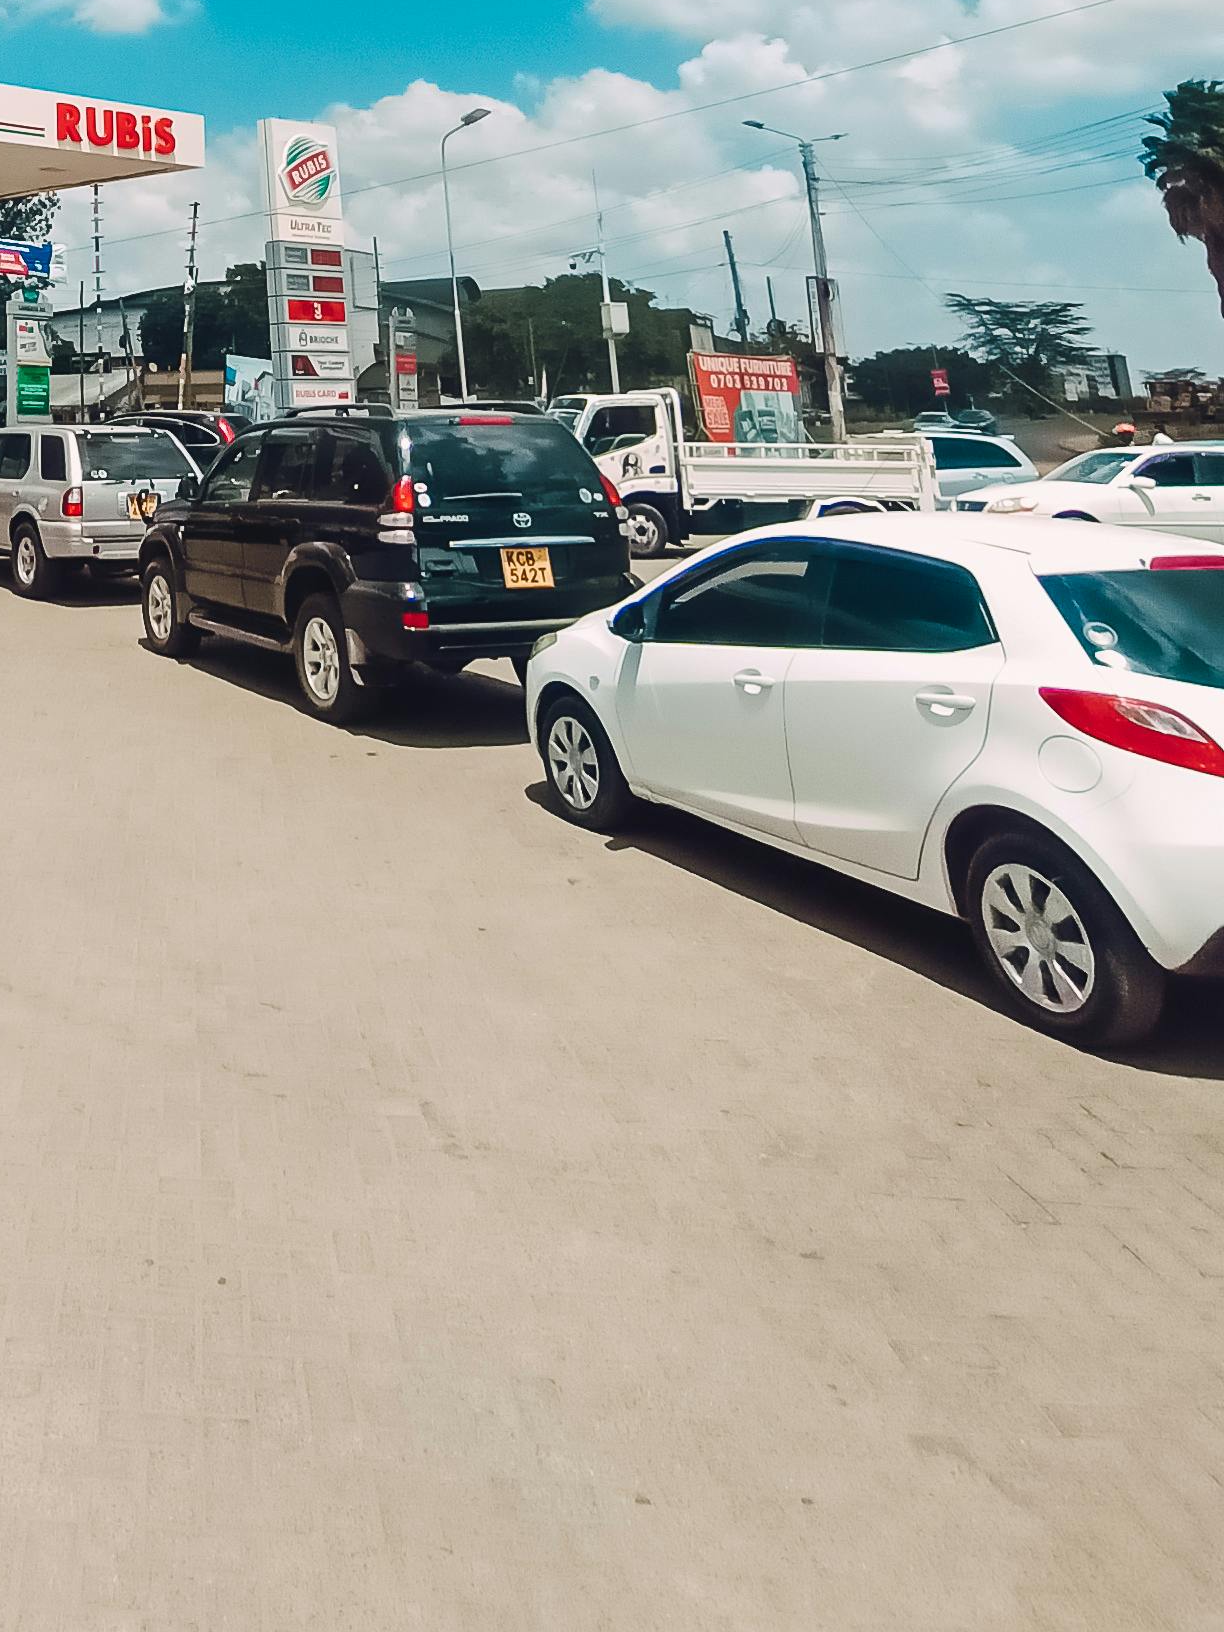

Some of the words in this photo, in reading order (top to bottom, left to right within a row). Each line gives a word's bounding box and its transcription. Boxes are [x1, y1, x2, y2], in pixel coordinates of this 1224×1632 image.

[291, 154, 327, 184] RUBIS
[698, 356, 740, 373] UNIQUE
[740, 358, 792, 376] FURNITURE
[710, 374, 741, 389] 0703
[767, 377, 788, 391] 703
[505, 550, 536, 568] KCB
[510, 567, 547, 584] 542T
